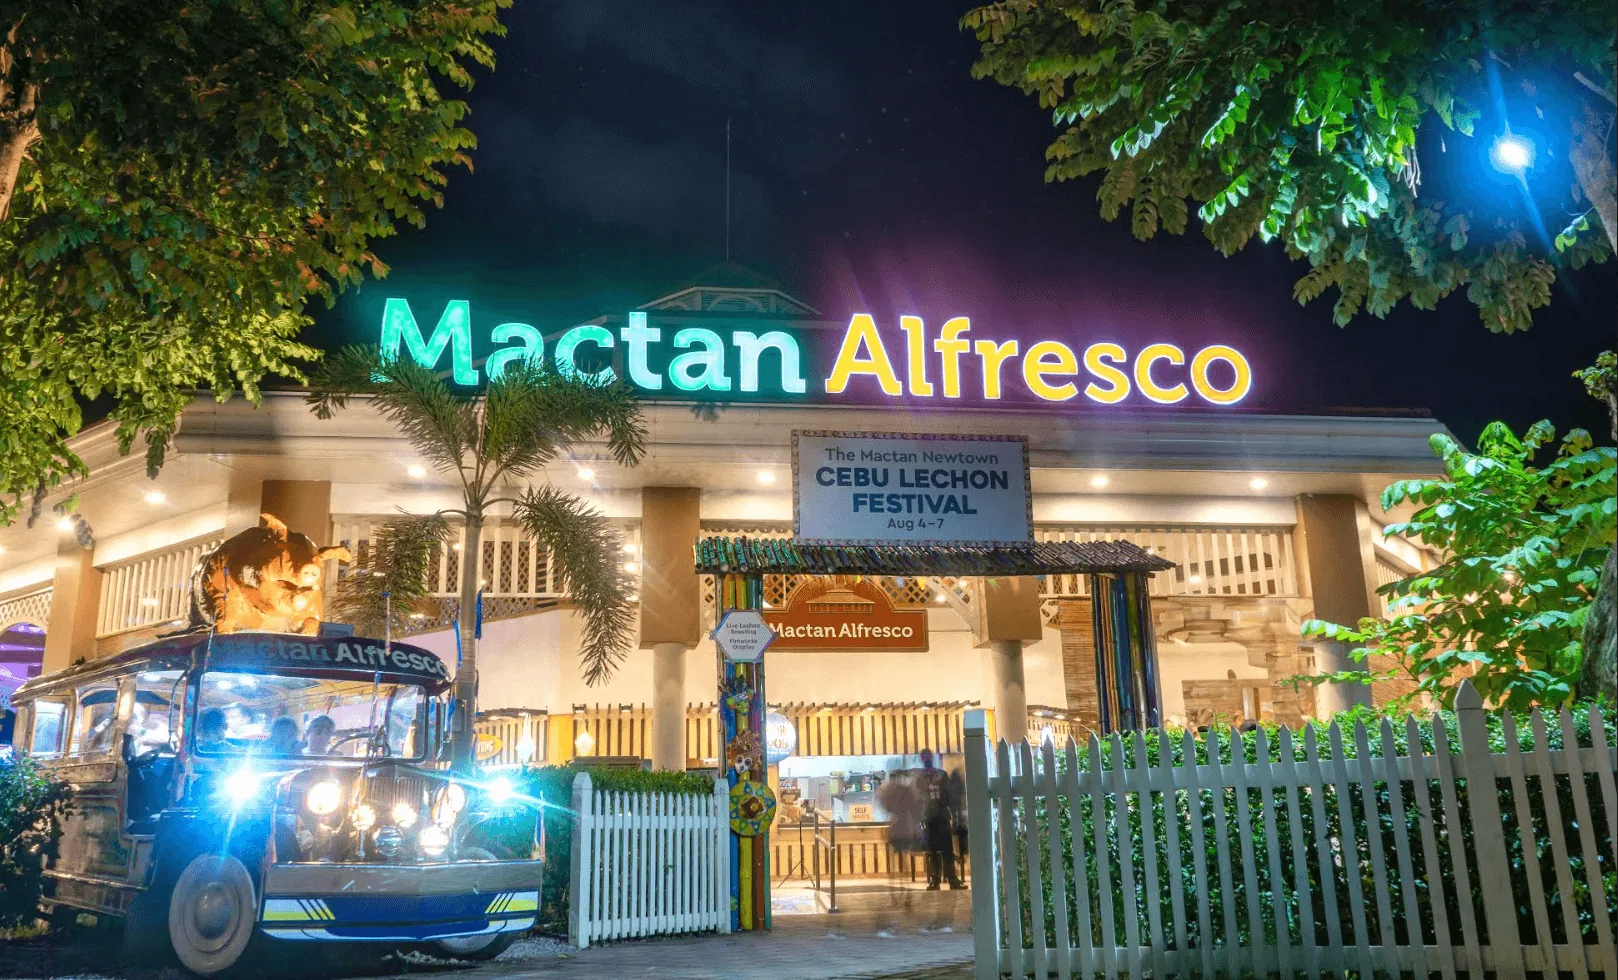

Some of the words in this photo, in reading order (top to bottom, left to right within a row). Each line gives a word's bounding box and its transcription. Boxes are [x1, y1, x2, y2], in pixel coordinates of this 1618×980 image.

[371, 298, 806, 394] Mactan
[824, 313, 1253, 405] Alfresco
[825, 447, 856, 462] The
[860, 448, 918, 463] Mactan
[923, 450, 999, 465] Newtown
[815, 466, 889, 488] CEBU
[899, 468, 1009, 490] LECHON
[852, 493, 978, 515] FESTIVAL
[887, 518, 914, 531] Aug
[768, 622, 837, 638] Mactan
[839, 622, 914, 639] Alfresco
[334, 642, 450, 677] Alfresco
